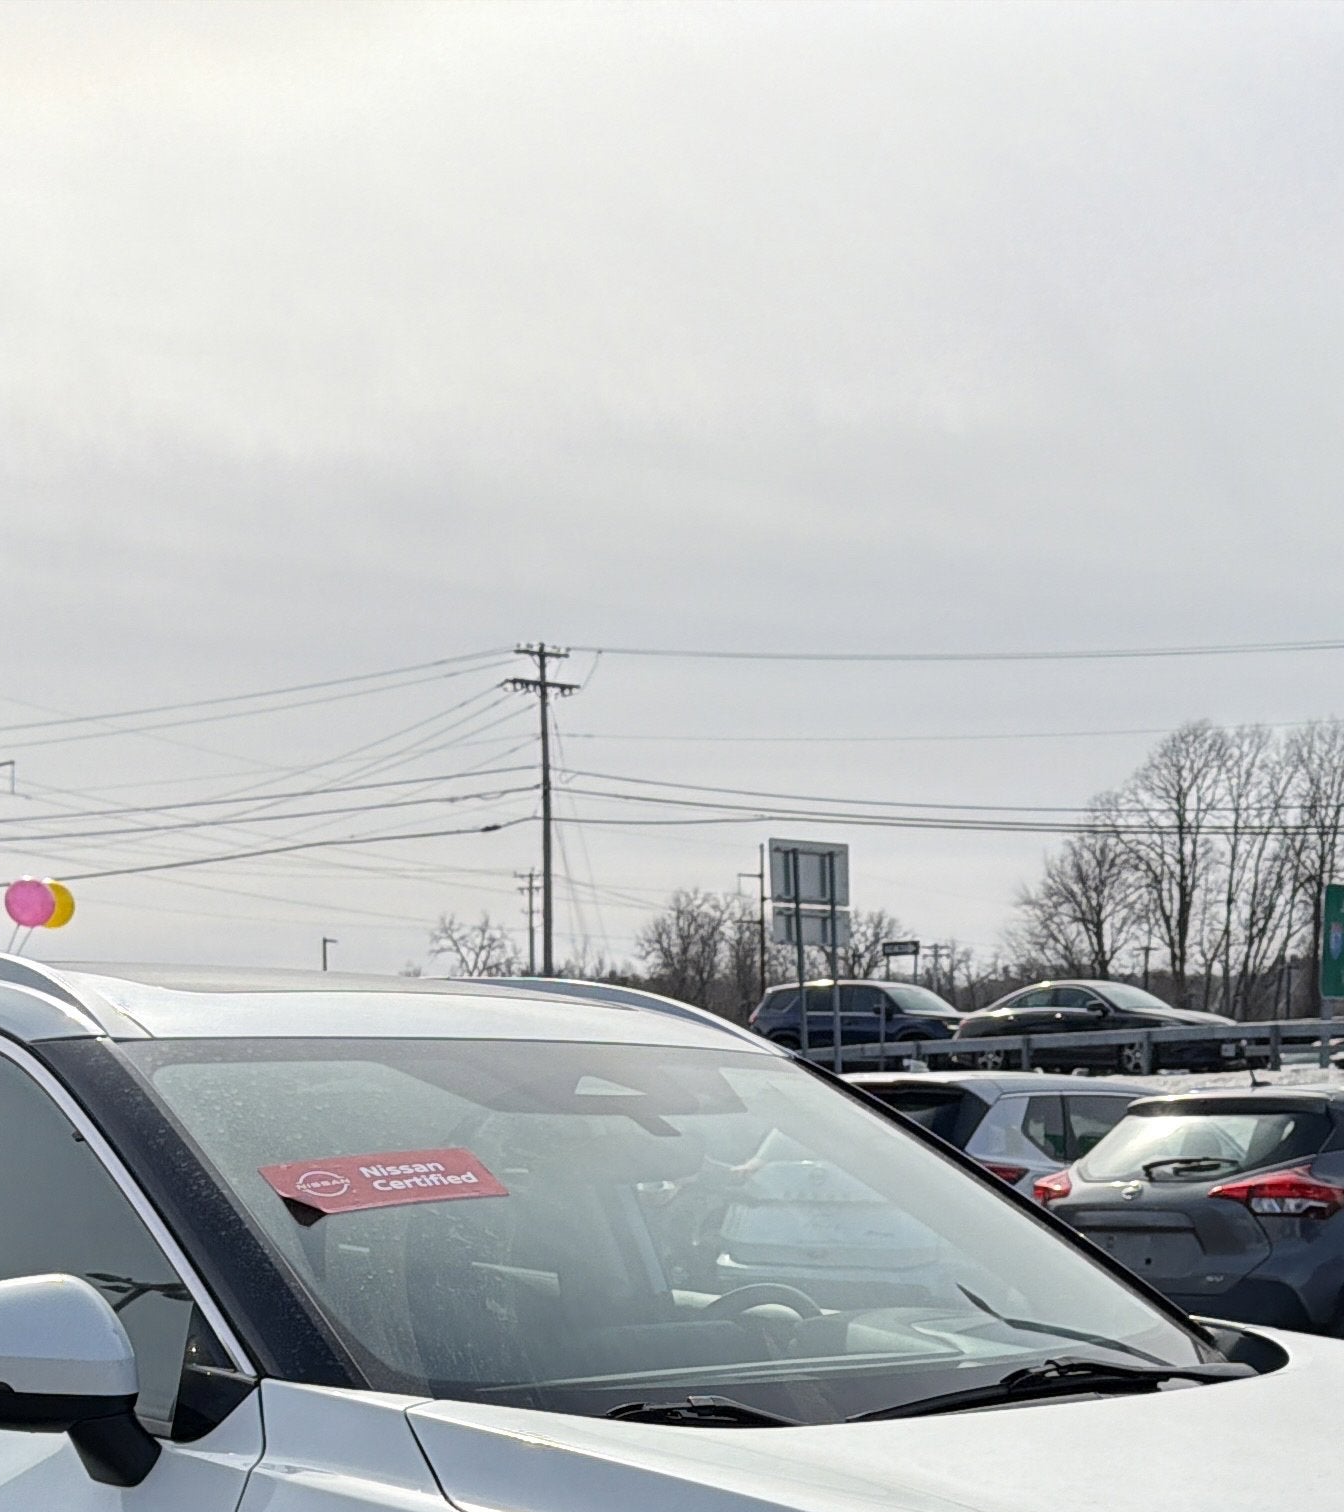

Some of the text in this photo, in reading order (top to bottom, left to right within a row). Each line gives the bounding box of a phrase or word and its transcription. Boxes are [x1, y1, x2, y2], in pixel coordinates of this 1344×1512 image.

[359, 1162, 446, 1178] Nissan
[295, 1177, 351, 1191] NISSAN
[372, 1171, 479, 1191] Certified
